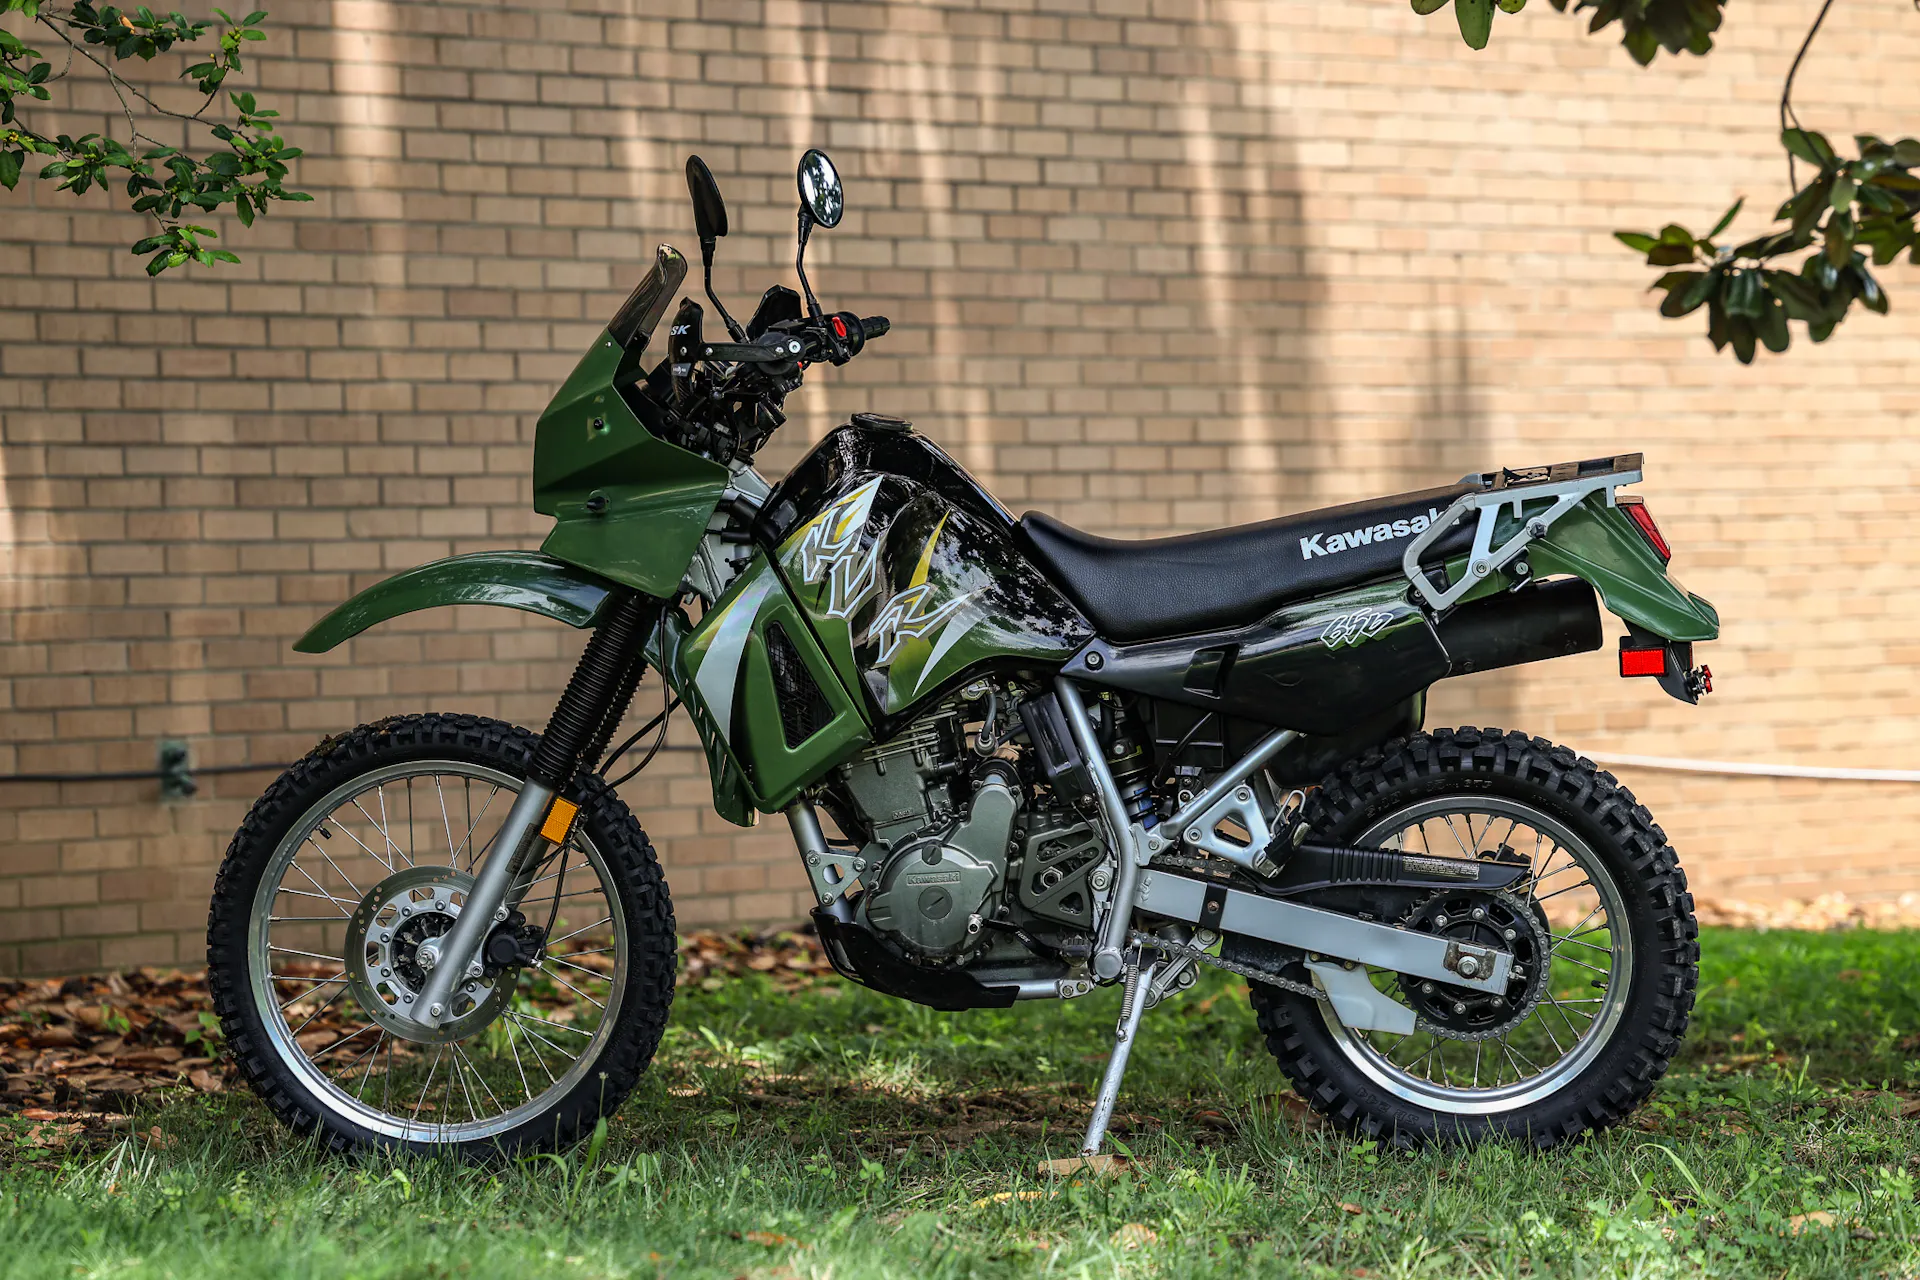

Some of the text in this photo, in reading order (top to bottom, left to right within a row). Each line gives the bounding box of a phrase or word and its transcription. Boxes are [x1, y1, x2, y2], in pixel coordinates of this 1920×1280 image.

[1300, 505, 1460, 560] Kawasa
[1320, 607, 1394, 648] 650
[908, 873, 959, 885] Kawasaki
